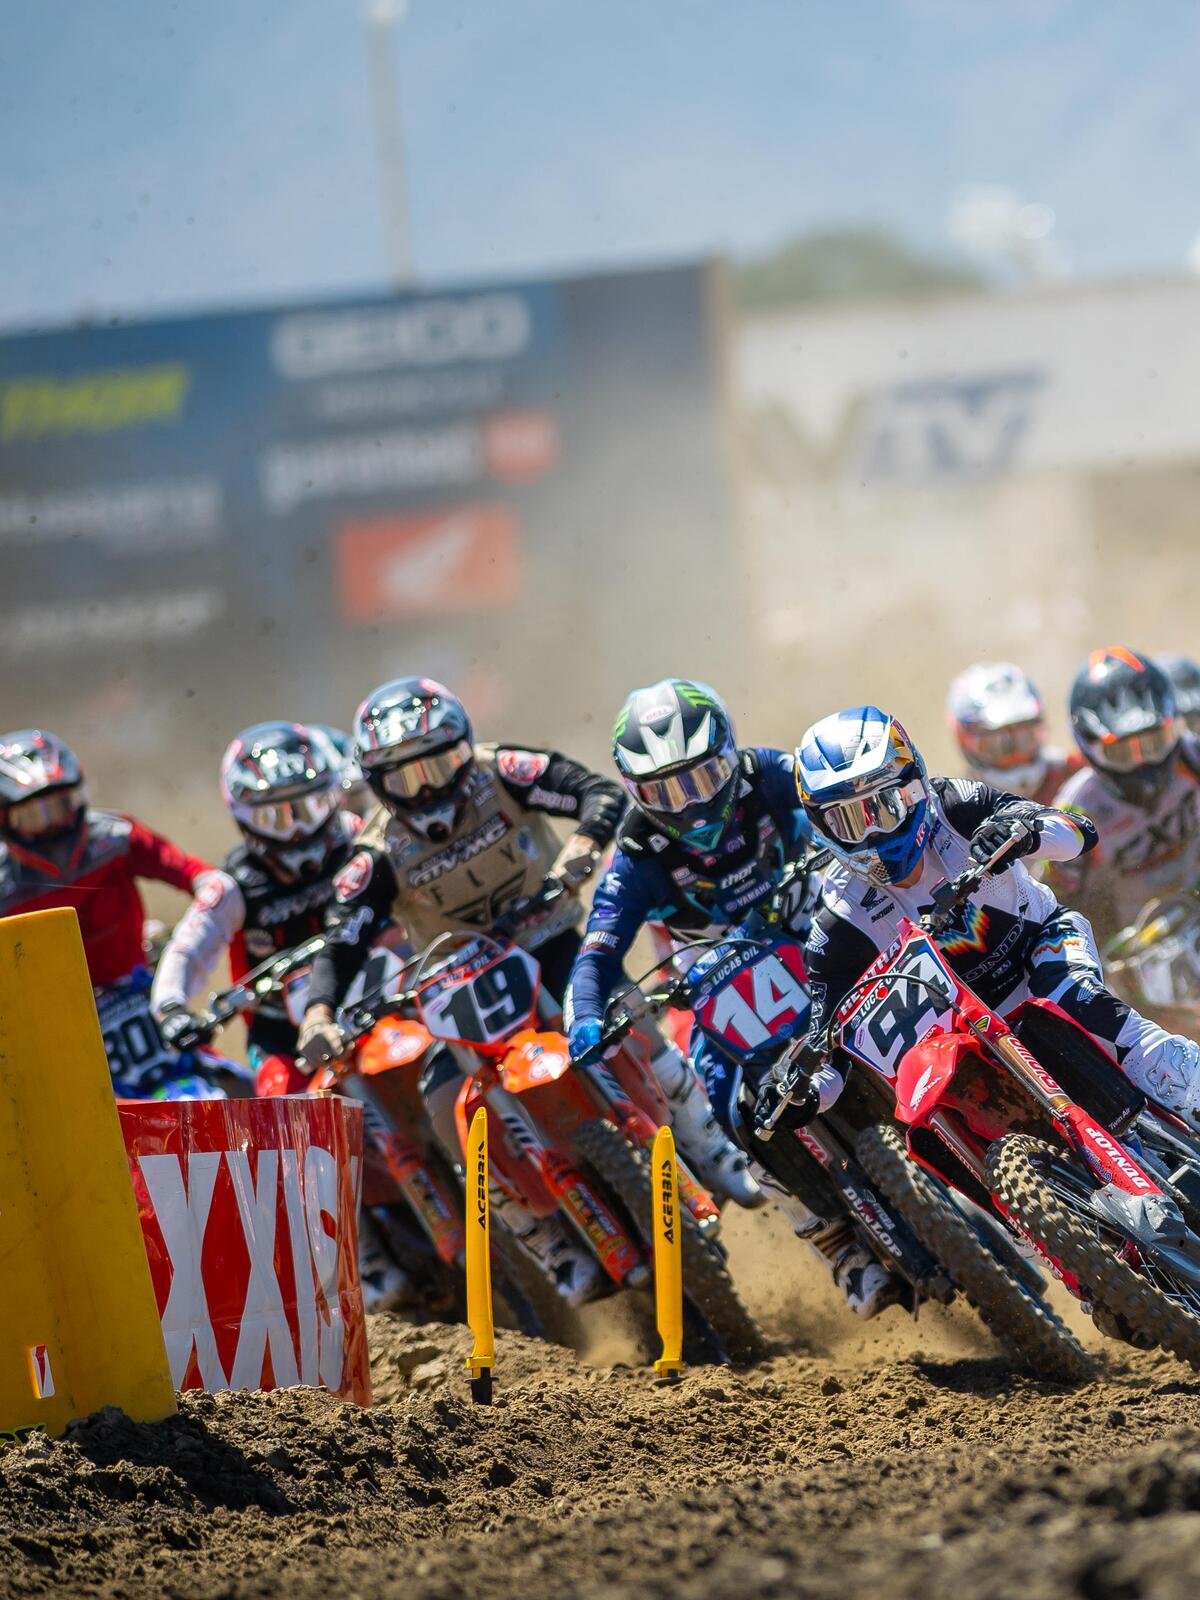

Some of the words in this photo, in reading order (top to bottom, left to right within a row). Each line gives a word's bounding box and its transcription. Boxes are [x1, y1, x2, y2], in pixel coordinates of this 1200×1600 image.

[721, 861, 758, 890] thor
[736, 881, 772, 906] YAMAHA
[712, 957, 742, 985] LUCAS
[742, 946, 760, 963] OIL
[841, 941, 901, 1016] RENTHA
[440, 955, 534, 1043] 19
[711, 954, 812, 1049] 14
[1084, 1127, 1151, 1188] DUNLOP
[842, 1185, 903, 1257] DUNLOP
